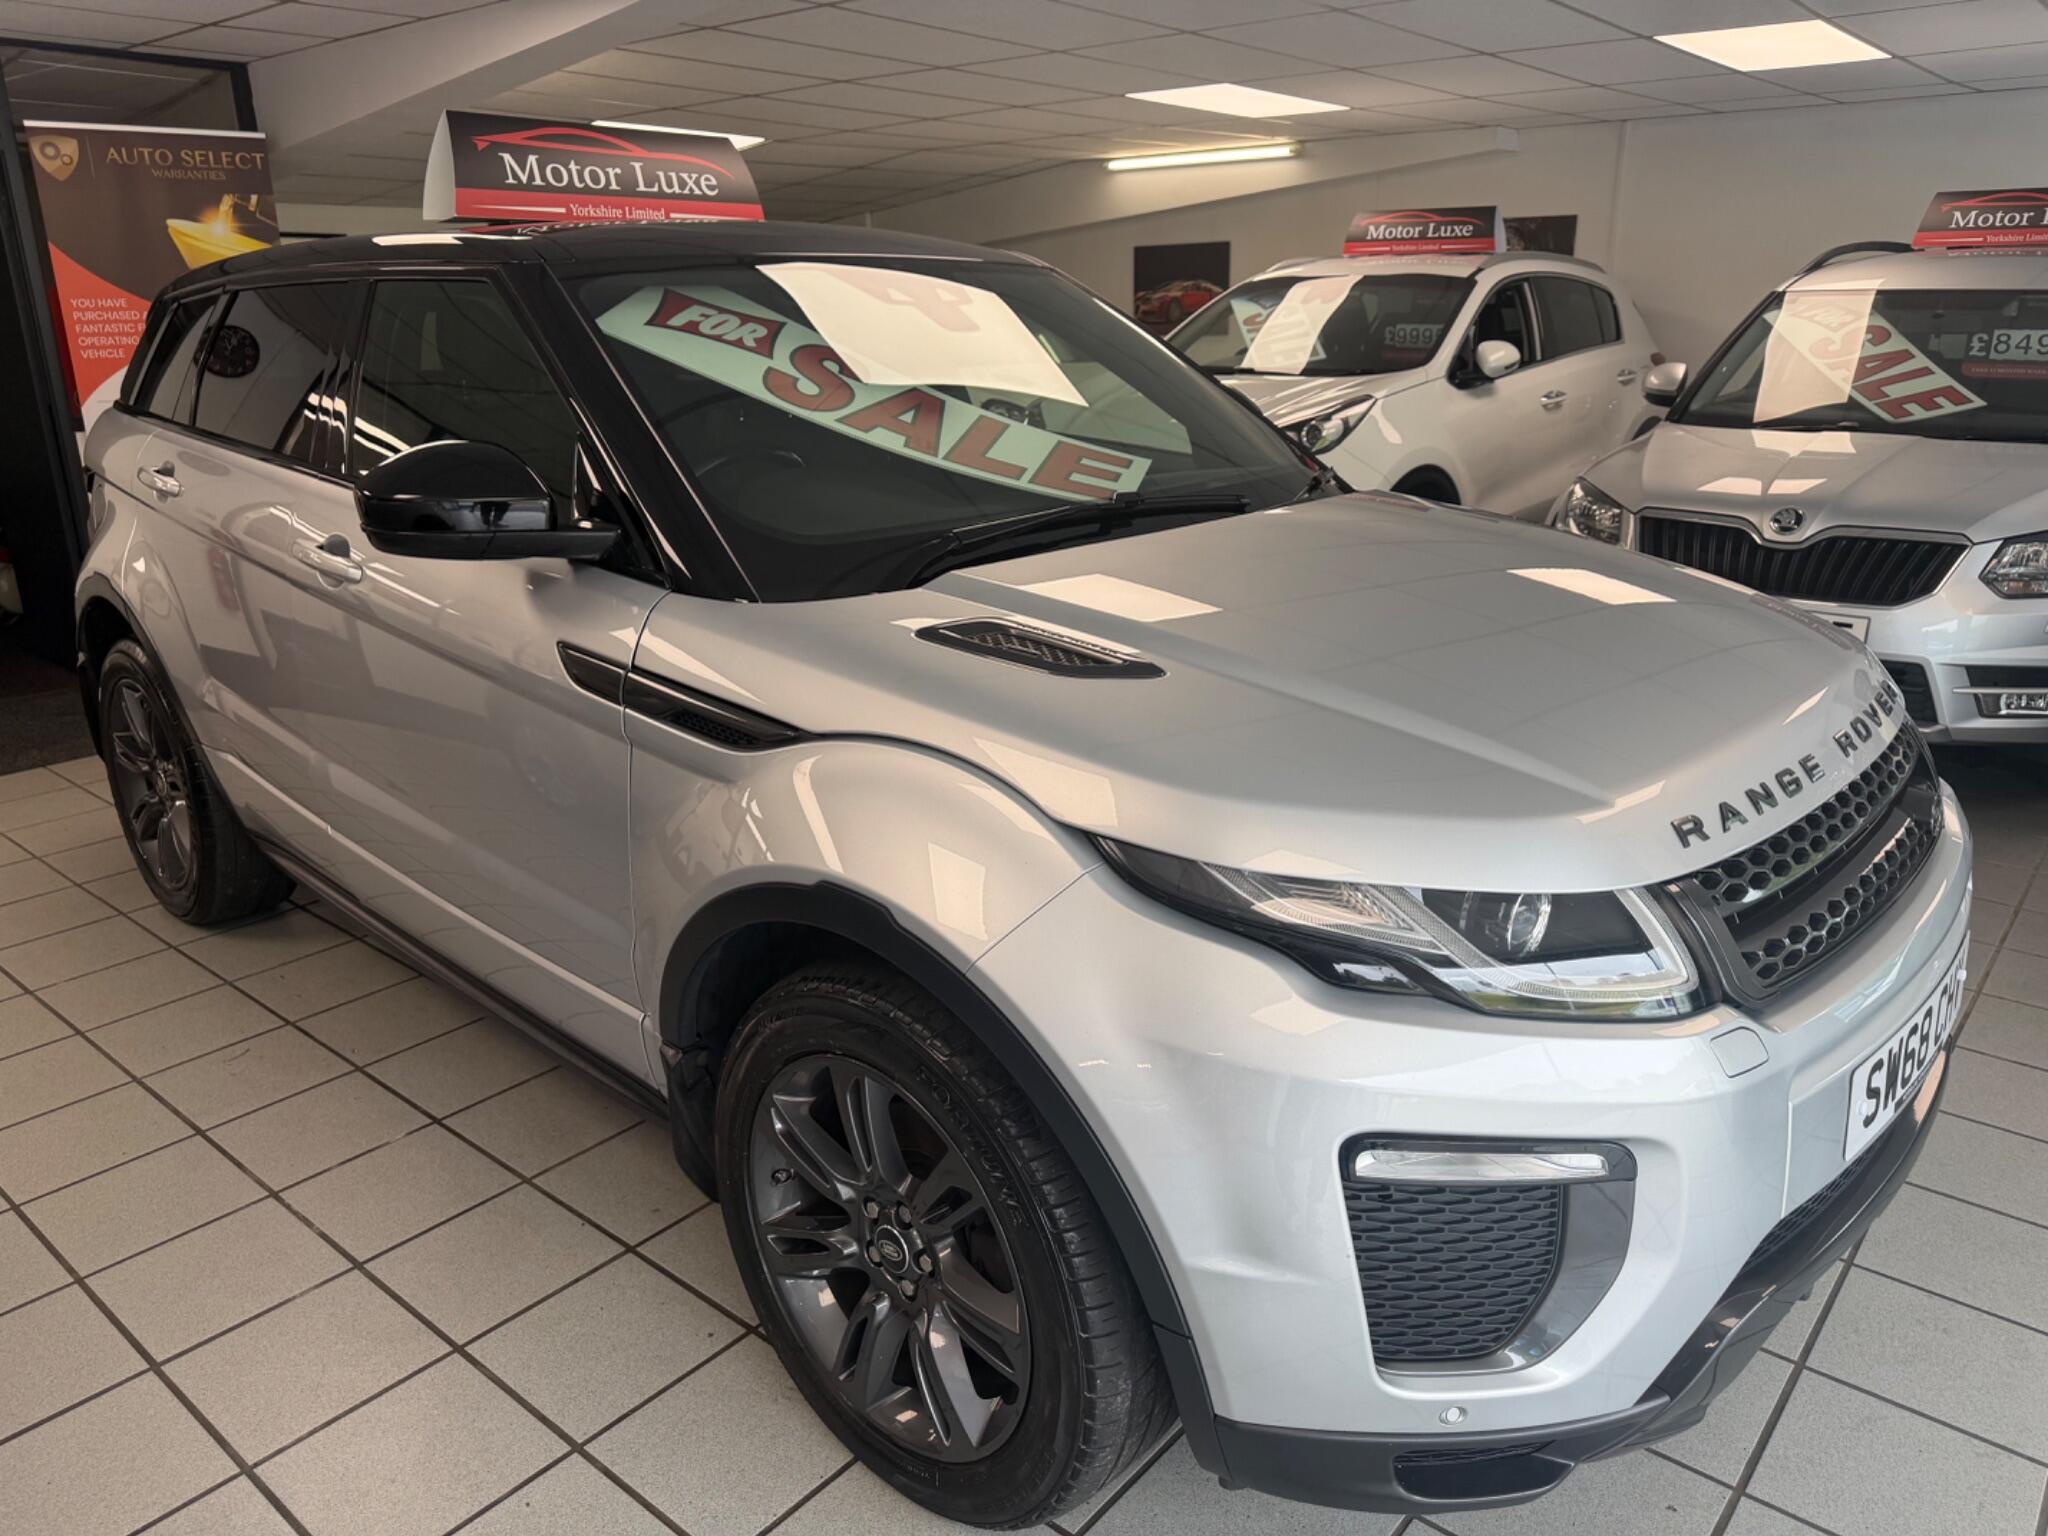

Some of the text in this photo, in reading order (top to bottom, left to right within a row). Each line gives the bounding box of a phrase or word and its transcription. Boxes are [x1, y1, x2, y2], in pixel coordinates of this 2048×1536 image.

[105, 146, 265, 170] AUTO SELECT
[151, 168, 226, 181] WARRANTIES
[498, 152, 720, 196] Motor Luxe
[570, 204, 666, 220] Yorkshire Limited
[1949, 210, 2035, 229] Motor
[1366, 223, 1474, 240] Motor Luxe
[69, 297, 129, 308] YOU HAVE
[72, 310, 141, 321] PURCHASED
[75, 322, 136, 334] FANTASTIC
[667, 304, 769, 348] FOR
[79, 347, 126, 359] VEHICLE
[763, 344, 1132, 499] SALE
[1670, 679, 1899, 848] RANGE ROVER
[1863, 1005, 1932, 1129] SW68
